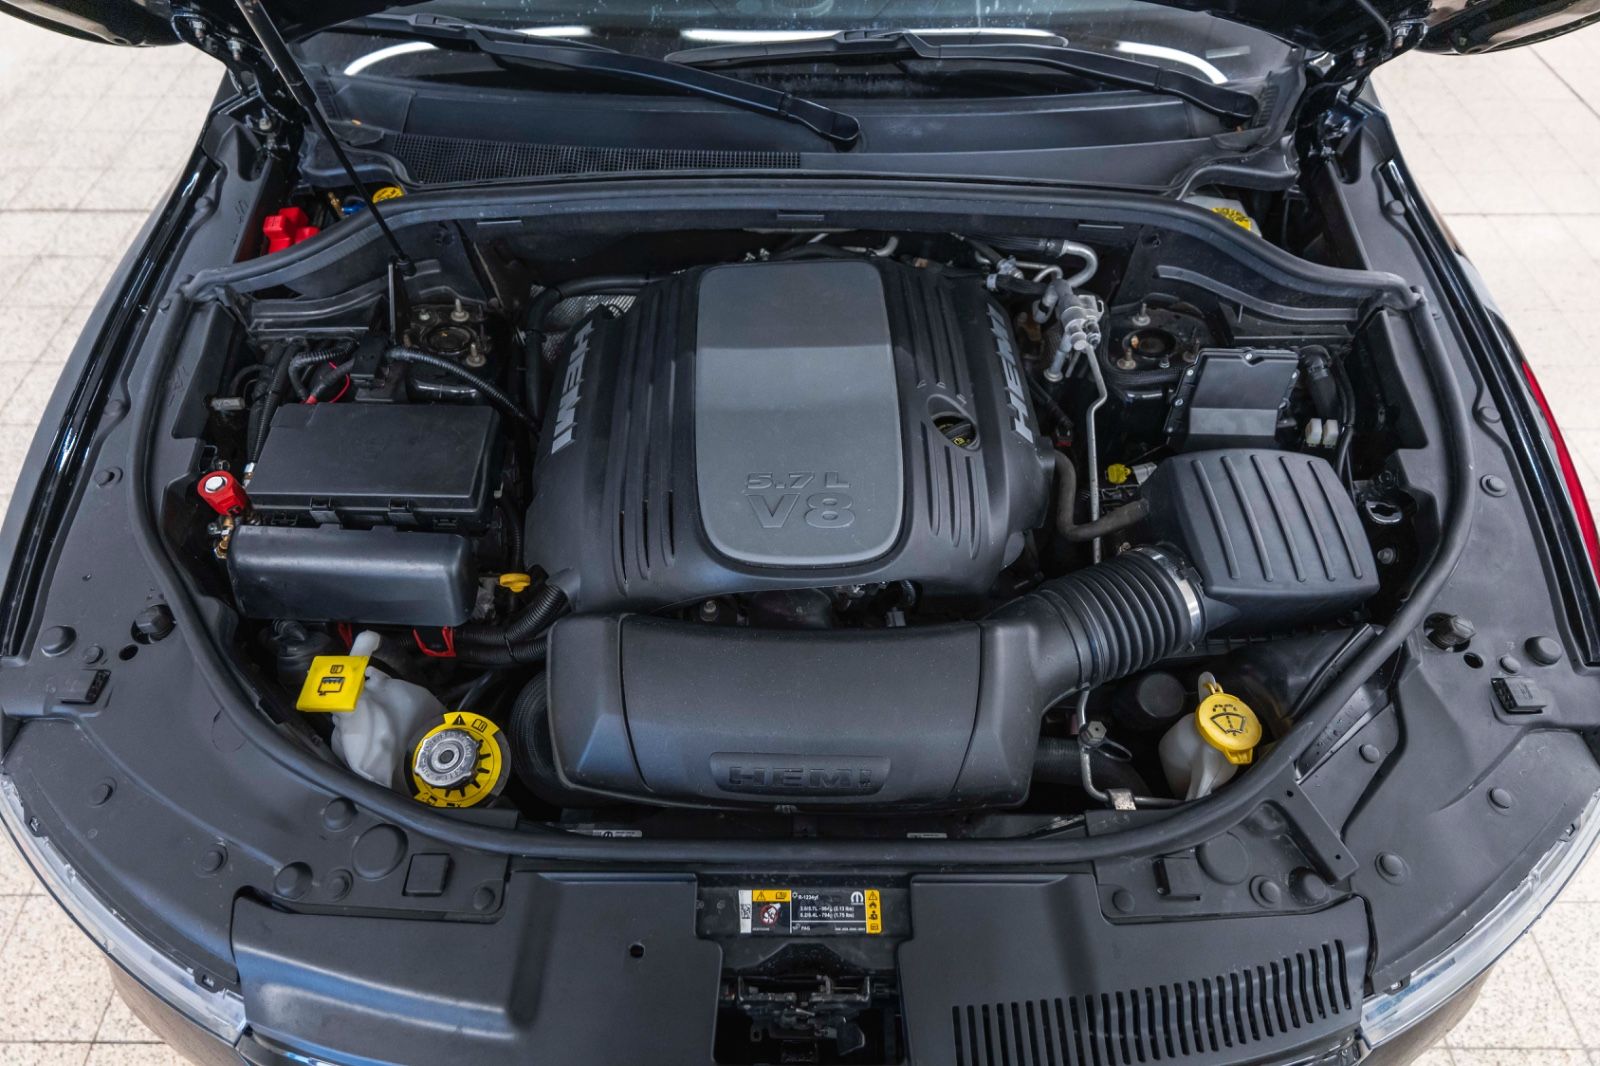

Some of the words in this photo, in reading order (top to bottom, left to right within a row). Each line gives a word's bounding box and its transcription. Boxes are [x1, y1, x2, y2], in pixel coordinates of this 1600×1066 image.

[551, 320, 594, 455] HEMI
[986, 303, 1034, 444] HEMI
[745, 492, 855, 529] V8
[729, 767, 873, 788] HEMI
